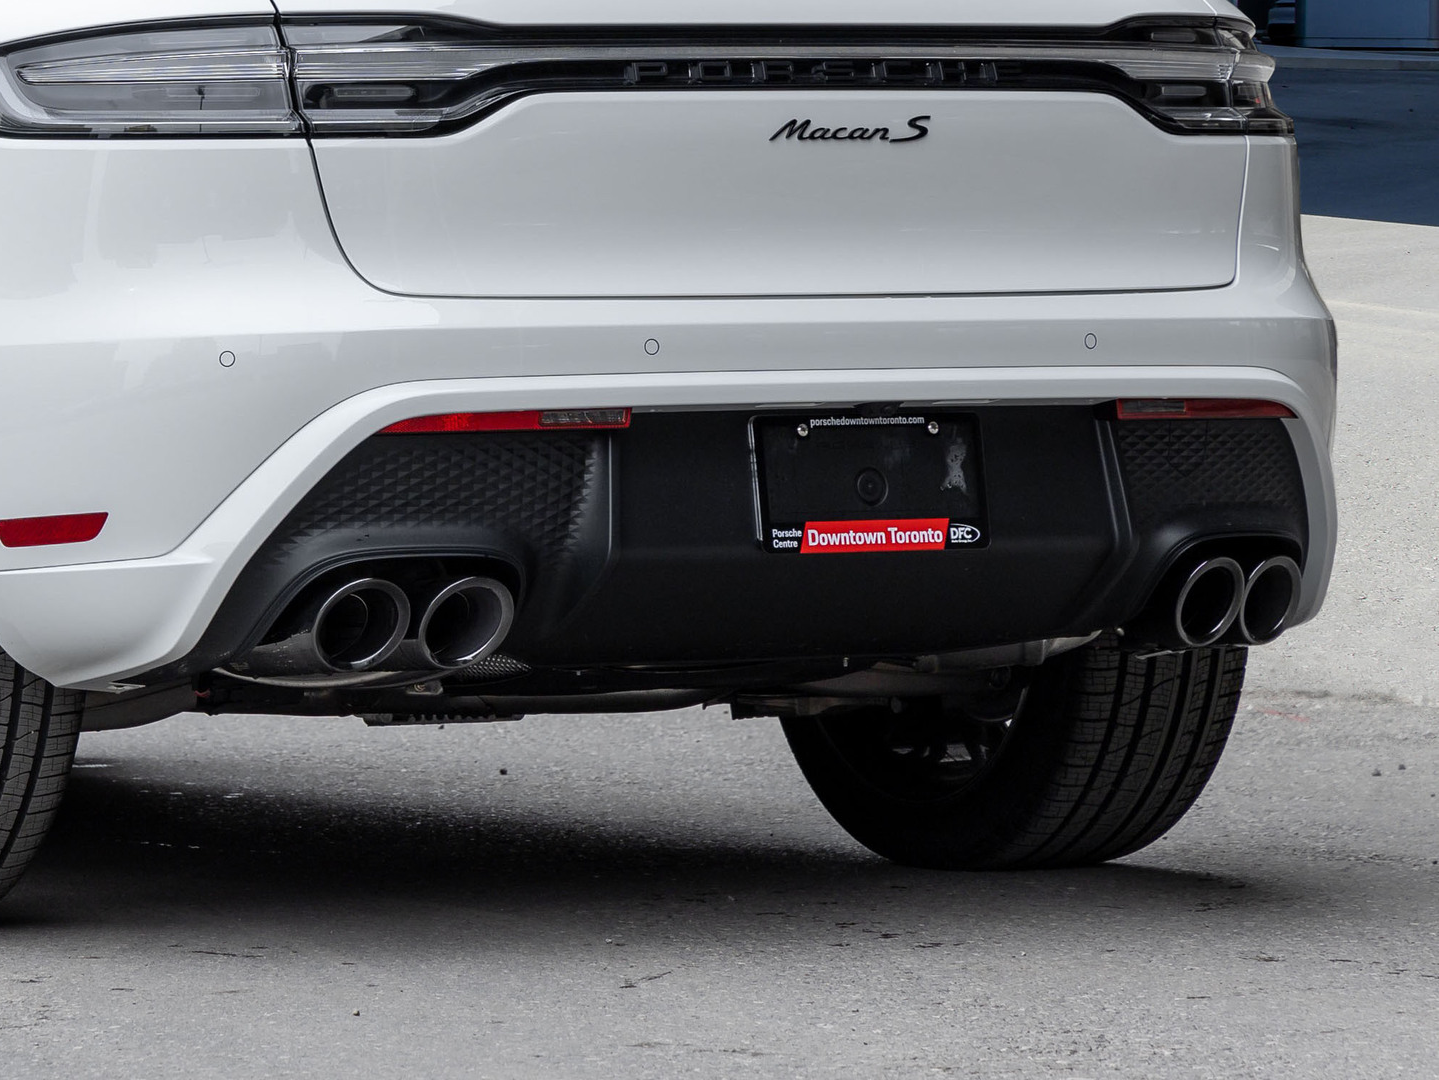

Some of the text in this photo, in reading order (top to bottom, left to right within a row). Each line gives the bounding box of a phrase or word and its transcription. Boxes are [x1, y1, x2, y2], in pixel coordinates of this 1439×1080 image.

[625, 60, 1025, 83] PORSCHE
[769, 116, 931, 143] Macan S
[810, 416, 925, 427] porschedowntowntoronto.com
[772, 528, 802, 538] Porsche
[807, 527, 943, 546] Downtown Toronto
[950, 527, 972, 540] DFC
[773, 539, 798, 549] Centre
